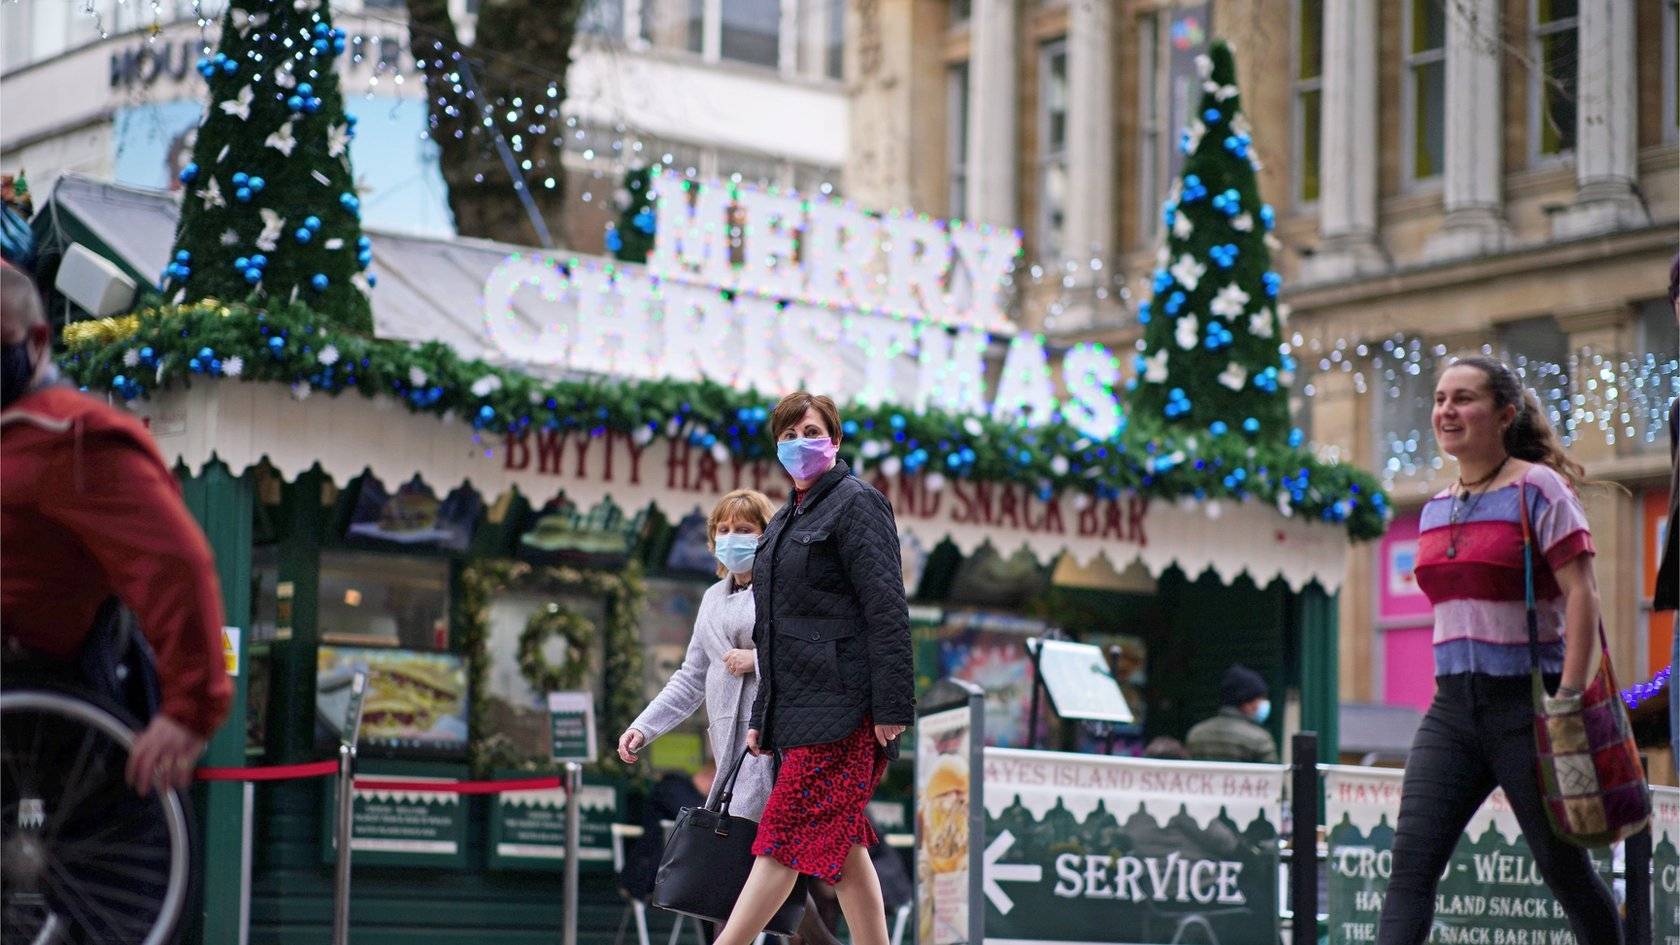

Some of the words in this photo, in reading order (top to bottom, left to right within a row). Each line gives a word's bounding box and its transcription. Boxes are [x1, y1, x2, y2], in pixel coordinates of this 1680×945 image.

[646, 166, 1023, 336] MERRY
[482, 250, 1124, 443] CHRISTMAS
[503, 424, 643, 486] BWYTY
[1077, 492, 1149, 548] BAR
[984, 760, 1047, 786] AYES
[1053, 766, 1134, 792] ISLAND
[1140, 771, 1213, 796] SNACK
[1221, 777, 1270, 799] BAR
[1054, 851, 1247, 905] SERVICE
[1434, 893, 1486, 916] SLAND
[1489, 896, 1548, 918] SNACK
[1341, 922, 1376, 943] THE
[1439, 926, 1490, 945] SNACK
[1494, 928, 1529, 945] BAR
[1531, 930, 1546, 945] IN
